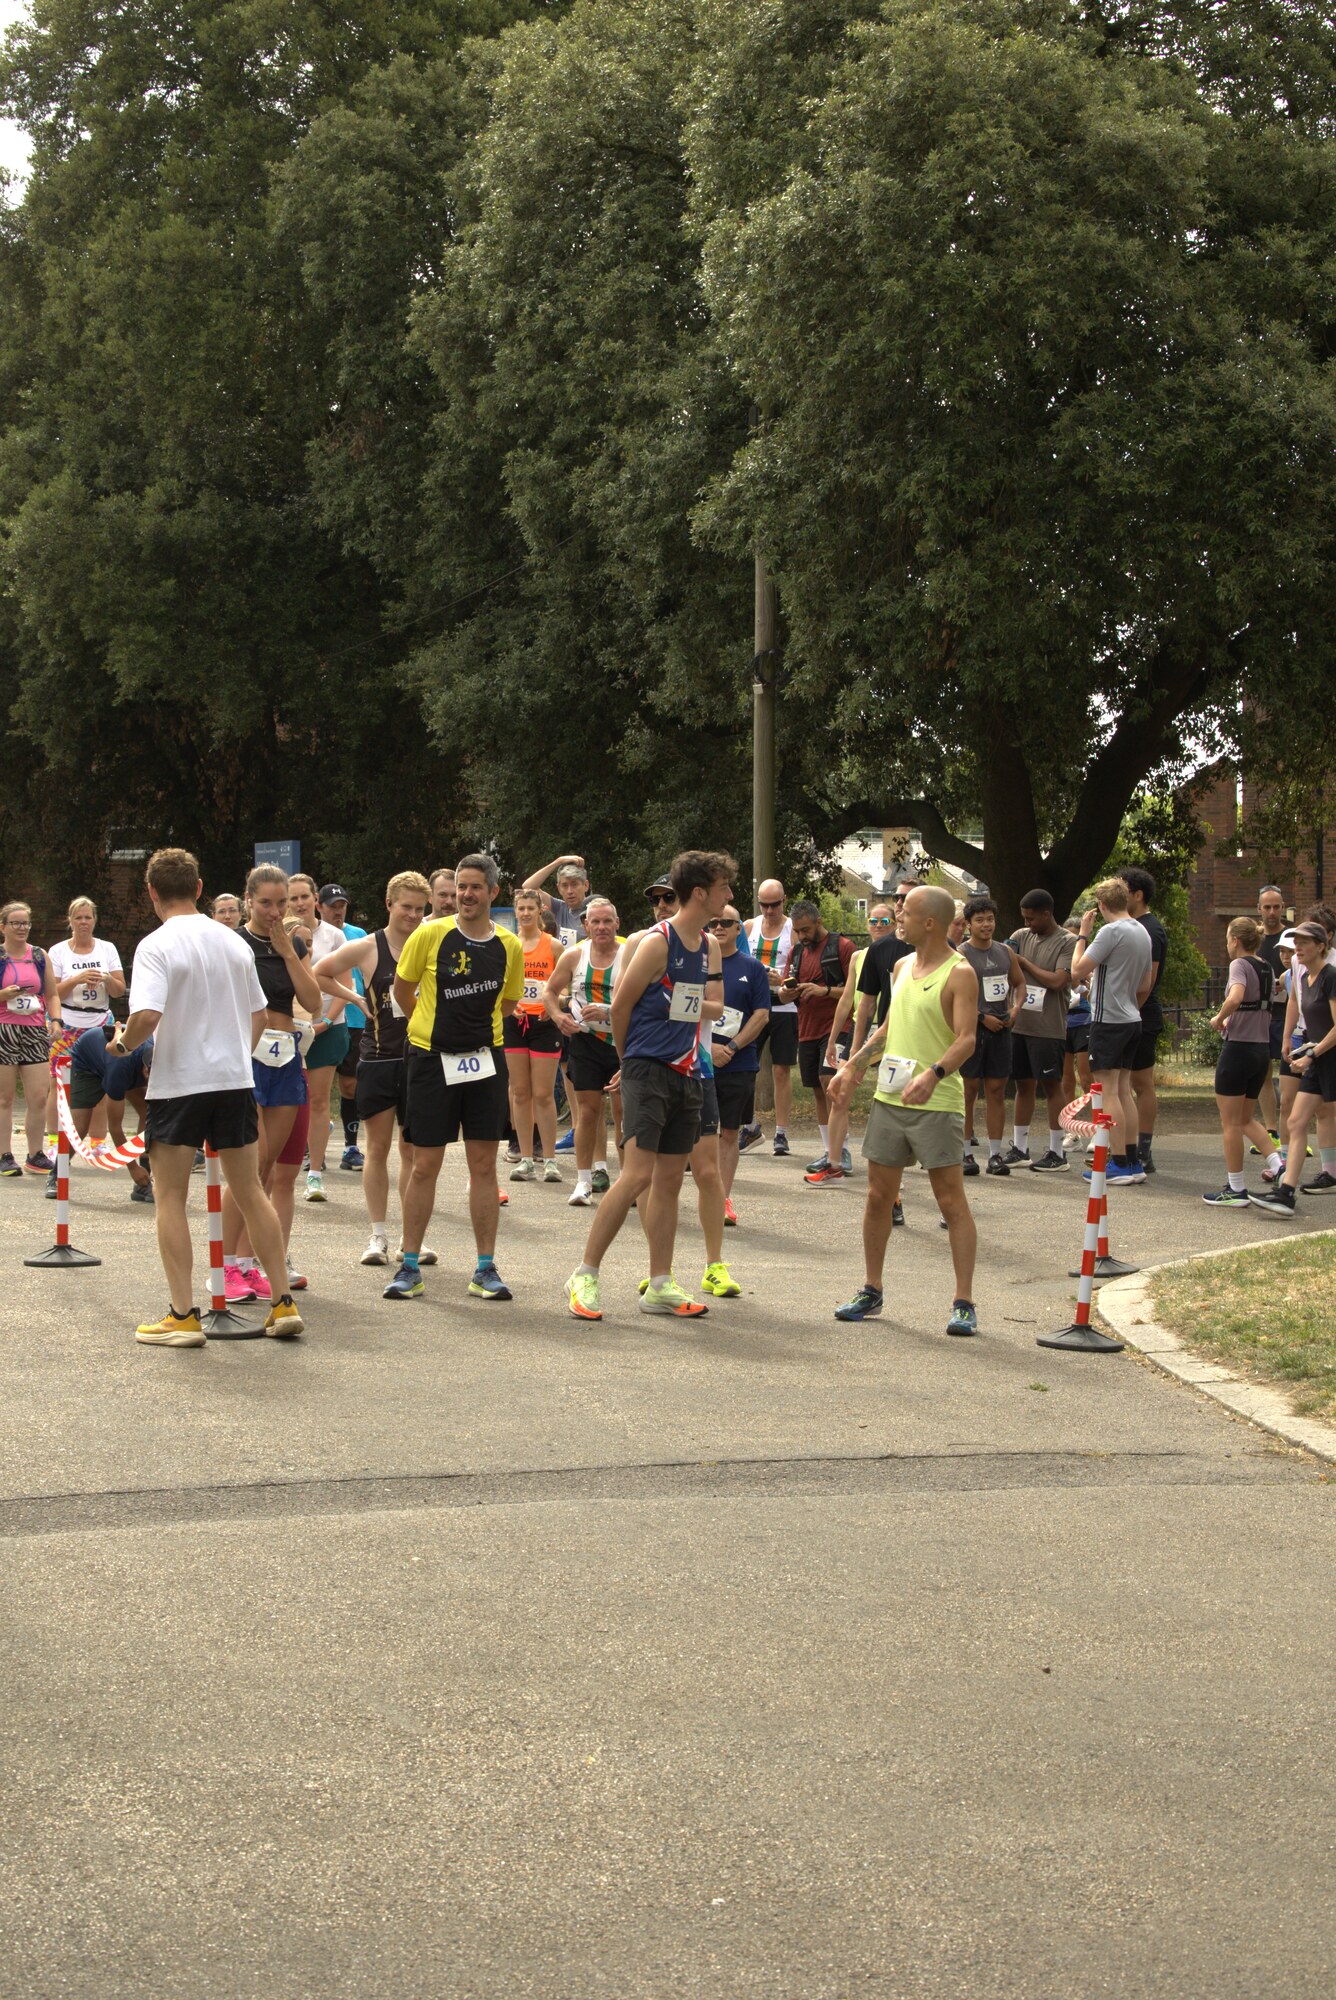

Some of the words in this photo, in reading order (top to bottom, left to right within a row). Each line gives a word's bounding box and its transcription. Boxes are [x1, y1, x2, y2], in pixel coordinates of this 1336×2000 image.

[72, 962, 101, 970] CLAIRE
[524, 961, 548, 969] PHAM
[82, 990, 98, 1001] 59
[444, 980, 498, 1000] Run&Frite
[992, 982, 1006, 996] 33
[16, 998, 32, 1010] 37
[684, 995, 700, 1013] 78
[268, 1041, 280, 1058] 4
[457, 1057, 480, 1073] 40
[888, 1066, 896, 1084] 7
